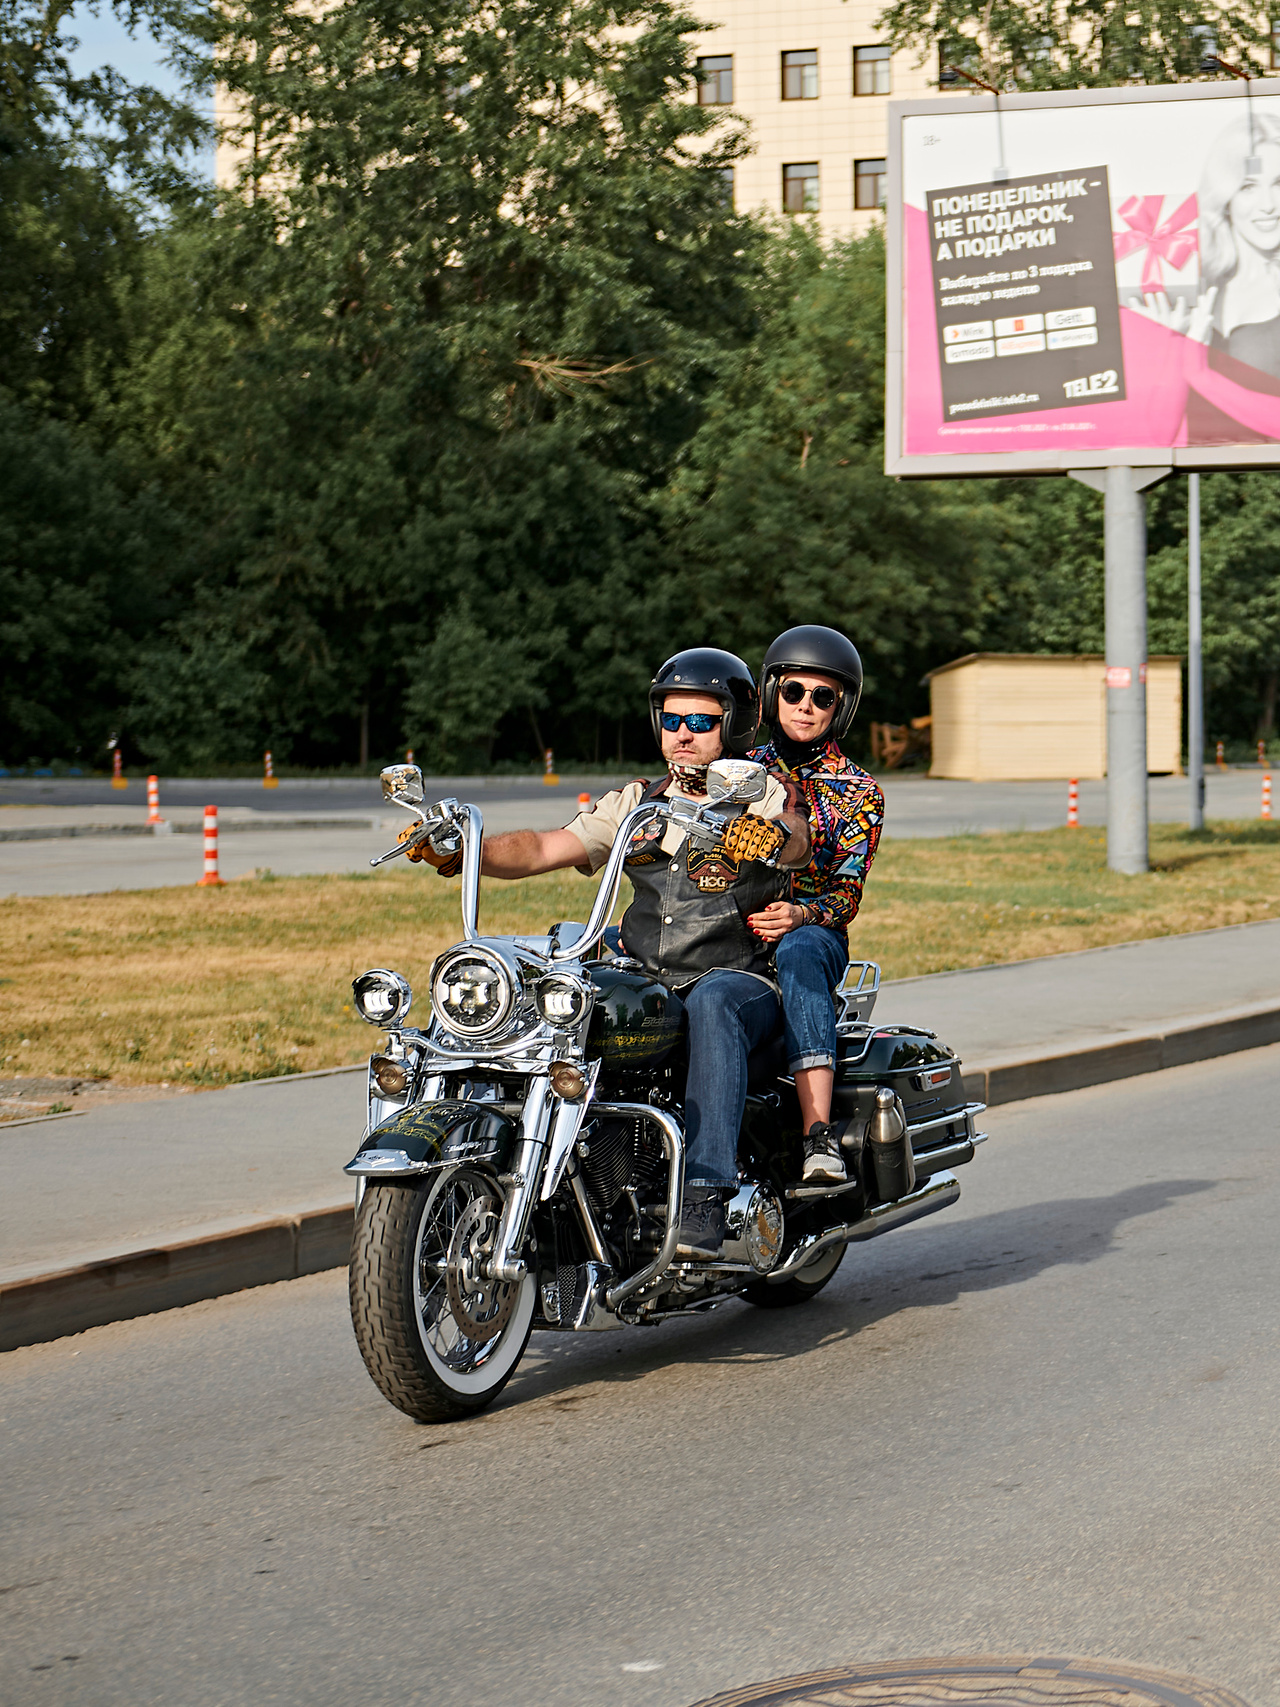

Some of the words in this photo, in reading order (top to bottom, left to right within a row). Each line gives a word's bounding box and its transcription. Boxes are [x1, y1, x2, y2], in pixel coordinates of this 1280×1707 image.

[932, 178, 1088, 217] ПОНЕДЕЛЬНИК
[934, 218, 964, 239] НЕ
[966, 203, 1074, 234] ПОДАРОК,
[936, 242, 953, 261] А
[955, 227, 1057, 258] ПОДАРКИ
[1028, 265, 1039, 278] 3
[1063, 369, 1119, 398] TELE2
